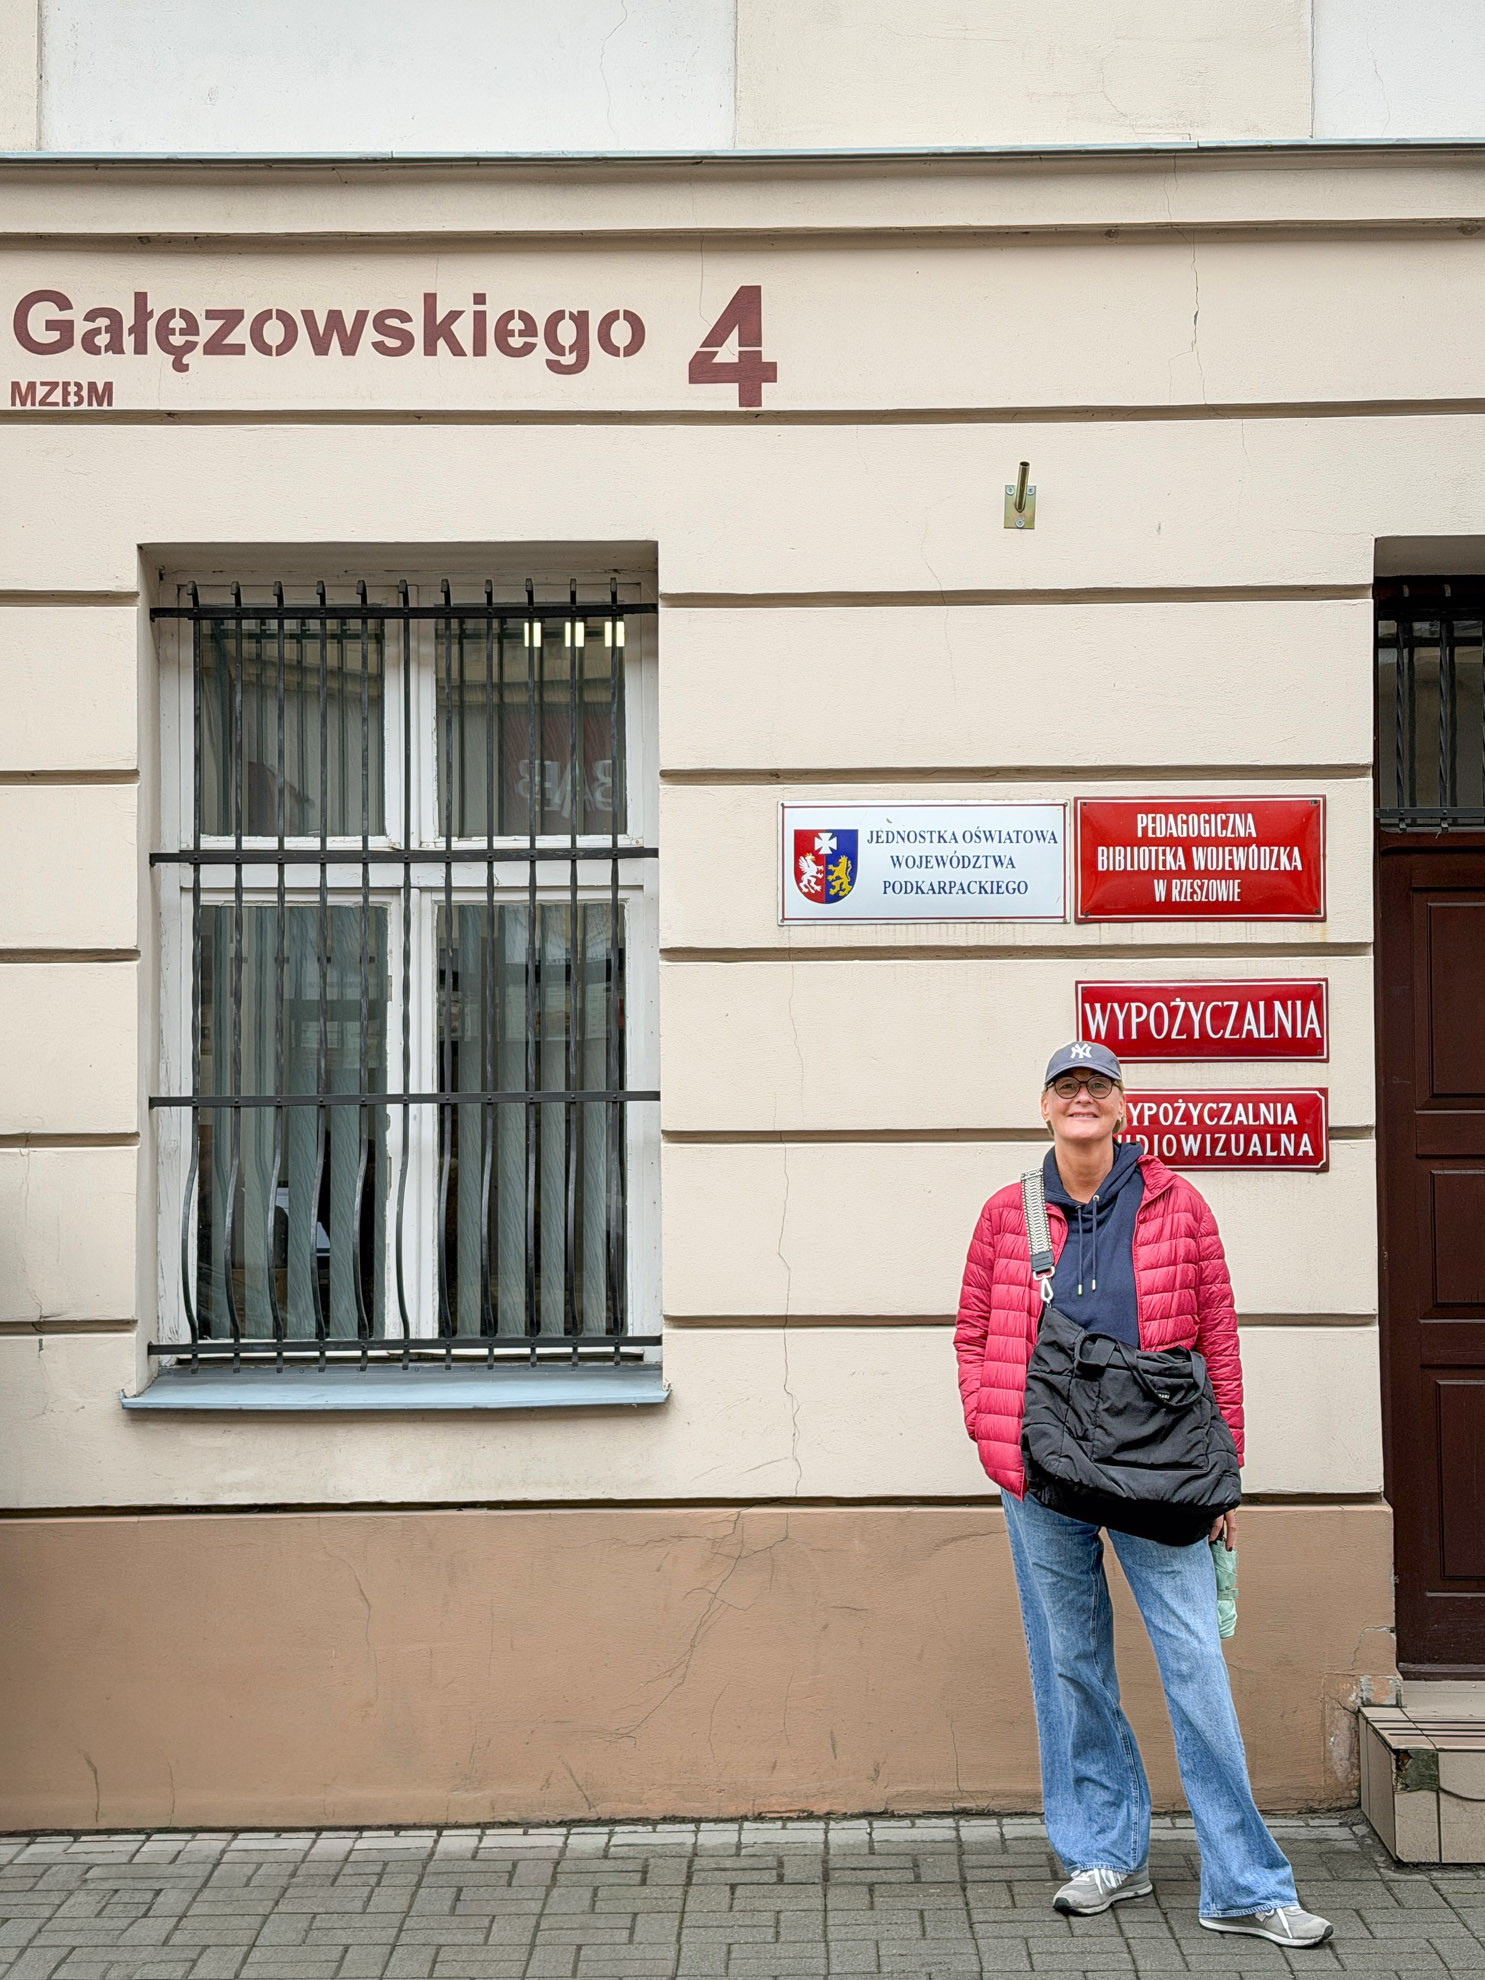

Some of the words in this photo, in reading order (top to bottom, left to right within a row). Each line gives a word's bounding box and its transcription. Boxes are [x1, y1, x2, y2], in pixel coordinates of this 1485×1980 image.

[13, 289, 646, 375] Gałęzowskiego
[688, 285, 778, 408] 4
[10, 380, 114, 407] MZBM
[867, 829, 959, 845] JEDNOSTKA
[962, 826, 1058, 844] OŚWIATOWA
[1136, 812, 1257, 838] PEDAGOGICZNA
[890, 851, 1016, 869] WOJEWÓDZTWA
[1097, 846, 1187, 871] BIBLIOTEKA
[1192, 843, 1303, 871] WOJEWÓDZKA
[882, 880, 1029, 895] PODKARPACKIEGO
[1153, 879, 1168, 902] W
[1171, 879, 1242, 902] RZESZOWIE
[1084, 997, 1322, 1040] WYPOŻYCZALNIA
[1070, 1043, 1092, 1059] NY
[1127, 1098, 1299, 1126] YPOŻYCZALNIA
[1117, 1133, 1315, 1157] DIOWIZUALNA
